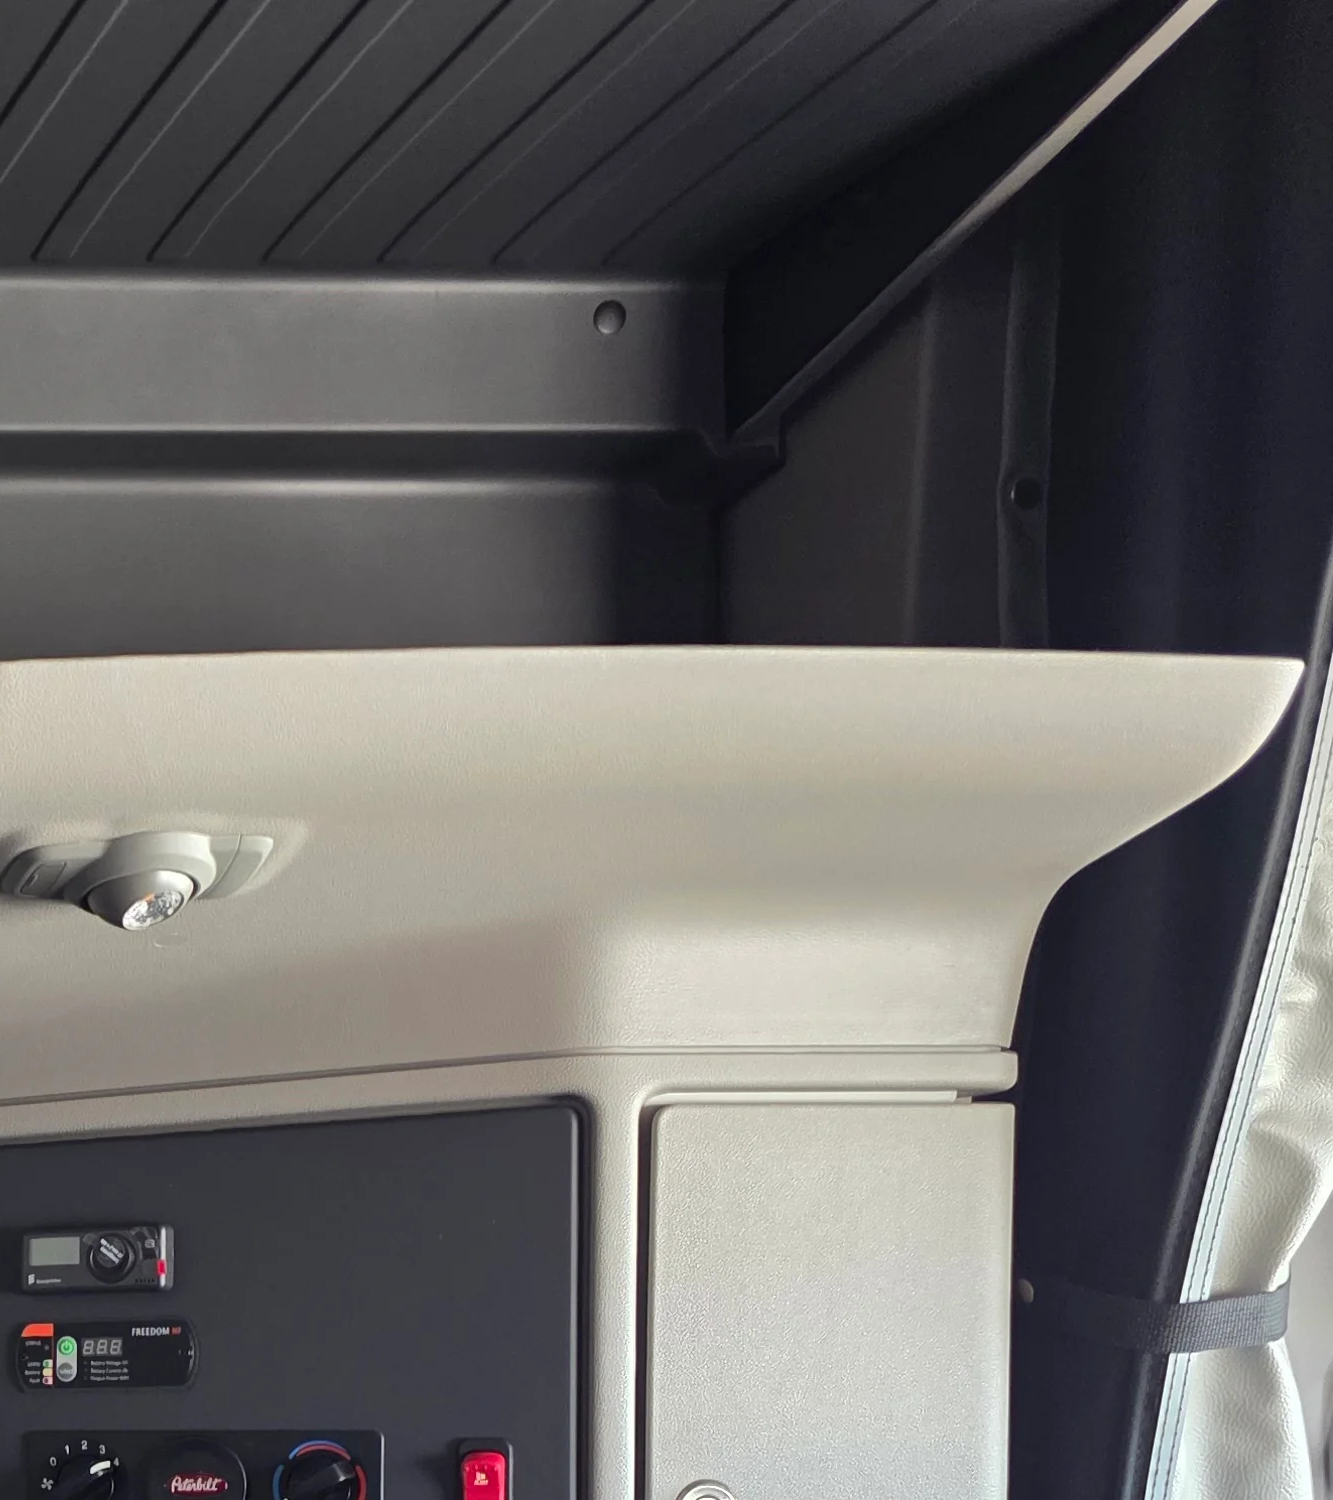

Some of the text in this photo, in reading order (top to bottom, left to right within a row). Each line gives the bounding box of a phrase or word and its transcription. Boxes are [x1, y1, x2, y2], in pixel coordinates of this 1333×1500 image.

[131, 1327, 170, 1337] FREEDOM
[64, 1445, 70, 1455] 1
[81, 1440, 88, 1450] 2
[99, 1445, 106, 1455] 3
[49, 1456, 57, 1466] 0
[113, 1457, 120, 1466] 4
[171, 1474, 222, 1494] Peterbilt
